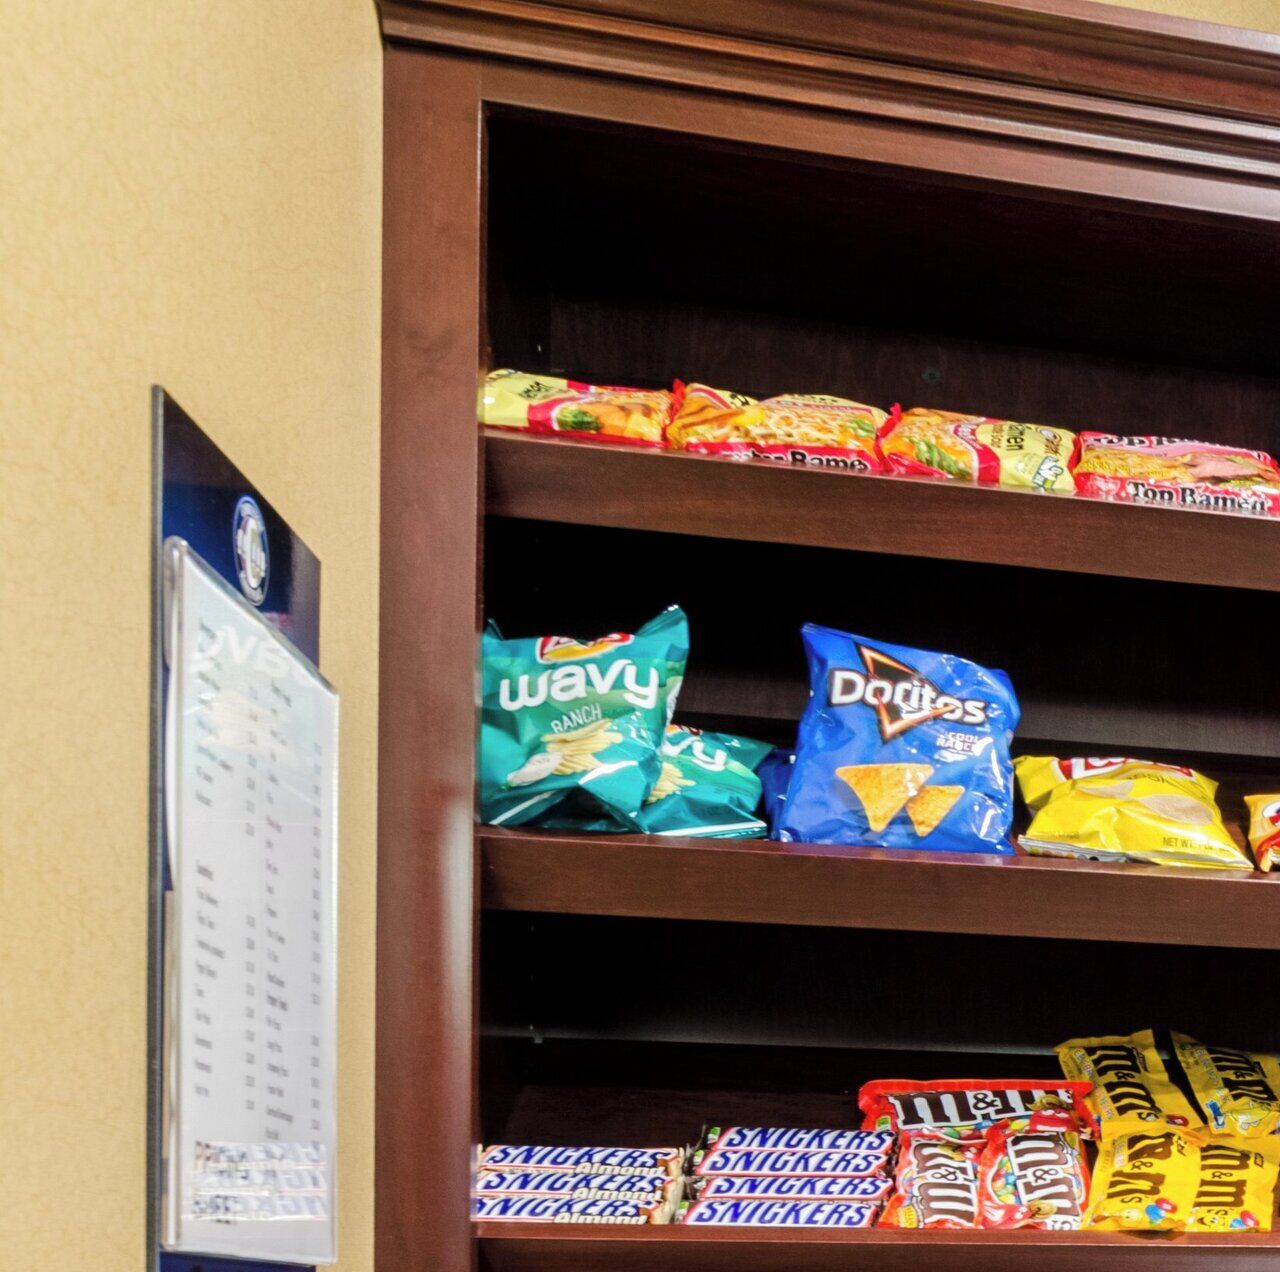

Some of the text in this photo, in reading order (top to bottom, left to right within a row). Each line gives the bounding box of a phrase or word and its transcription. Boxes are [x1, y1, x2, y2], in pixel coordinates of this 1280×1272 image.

[1127, 481, 1272, 511] Top Ramen
[499, 659, 660, 711] wavy
[831, 670, 986, 725] Doritos
[551, 703, 602, 734] RANCH
[725, 1126, 896, 1151] SNICKERS
[489, 1145, 673, 1168] SNICKERS
[708, 1151, 882, 1172] SNICKERS
[574, 1162, 666, 1176] Almond
[485, 1172, 671, 1193] SNICKERS
[572, 1187, 663, 1201] Almond
[713, 1177, 889, 1196] SNICKERS
[554, 1213, 648, 1225] Almond
[694, 1201, 873, 1226] SNICKERS
